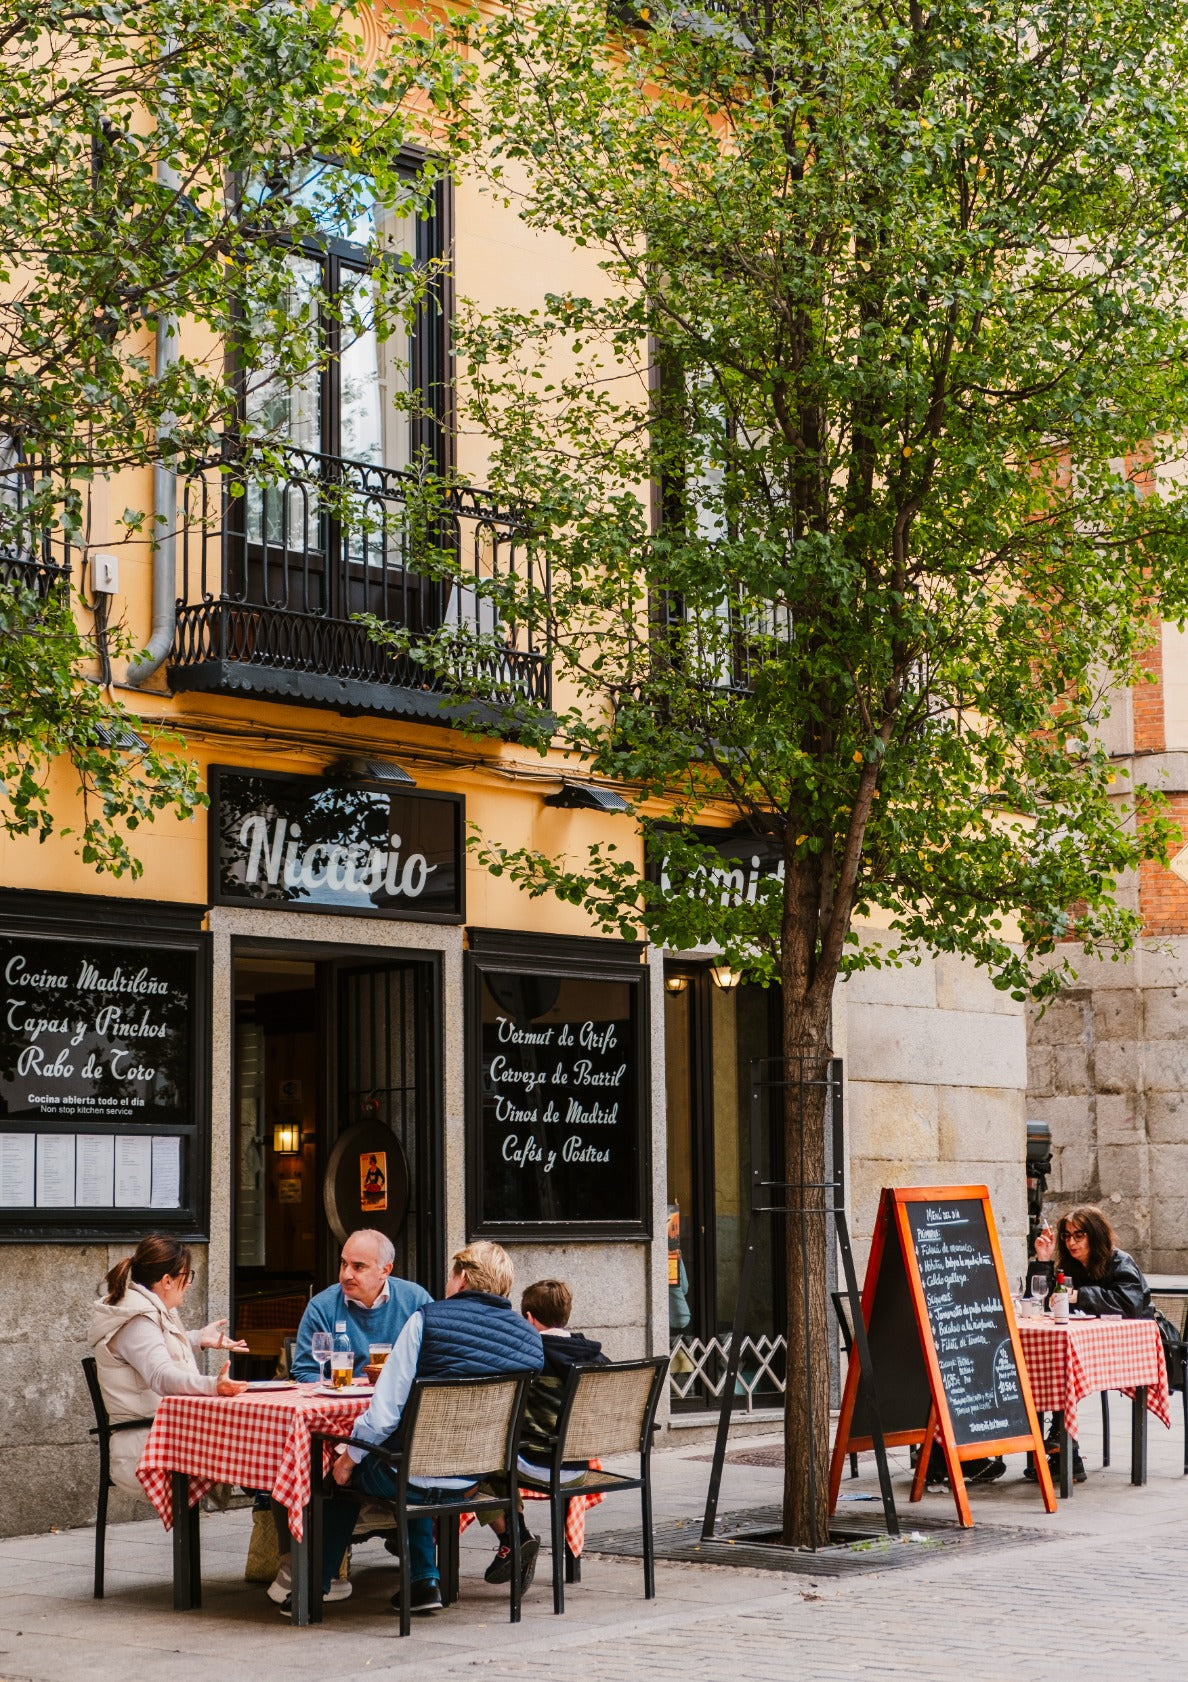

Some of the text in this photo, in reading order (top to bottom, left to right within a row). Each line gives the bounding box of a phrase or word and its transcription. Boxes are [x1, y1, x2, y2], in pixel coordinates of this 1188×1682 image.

[240, 815, 438, 898] Nicasio
[5, 955, 169, 995] Cocina Madrileña
[6, 998, 167, 1046] Tapas y Pinchos
[495, 1016, 618, 1055] Vermut de Grifo
[17, 1045, 156, 1081] Rabo de Toro
[489, 1055, 627, 1093] Cerveza de Barril
[27, 1094, 61, 1104] Cocina
[62, 1095, 96, 1106] abierta
[97, 1097, 118, 1106] todo
[119, 1097, 129, 1106] el
[40, 1104, 134, 1117] Non stop kitchen service
[493, 1094, 619, 1125] Vinos de Madrid
[501, 1134, 610, 1173] Cafés y Postres
